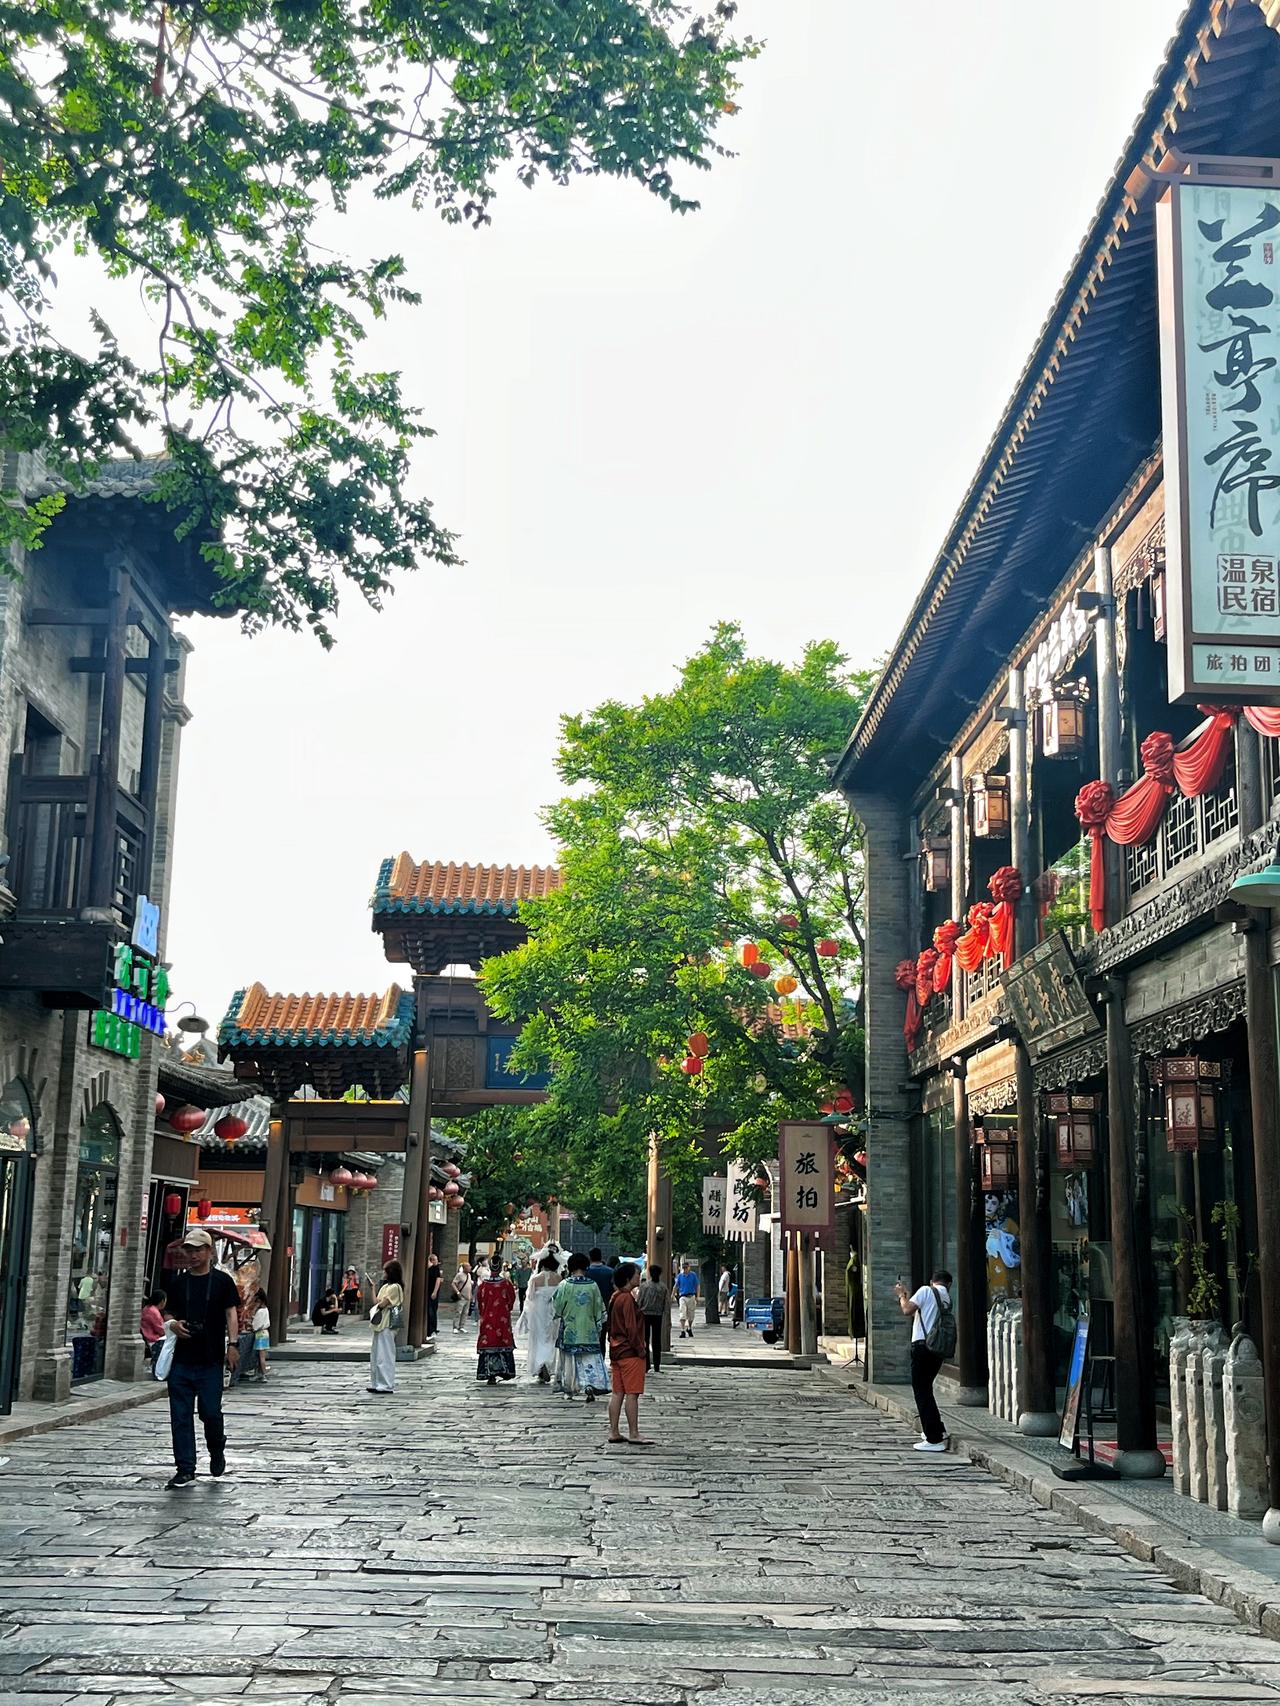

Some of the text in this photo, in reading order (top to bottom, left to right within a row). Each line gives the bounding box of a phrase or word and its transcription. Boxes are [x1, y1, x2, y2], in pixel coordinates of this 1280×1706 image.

[1221, 558, 1275, 585] 温泉
[1222, 585, 1276, 612] 民宿
[1206, 653, 1280, 673] 旅拍团
[794, 1151, 820, 1210] 旅拍
[708, 1189, 722, 1218] 醋坊
